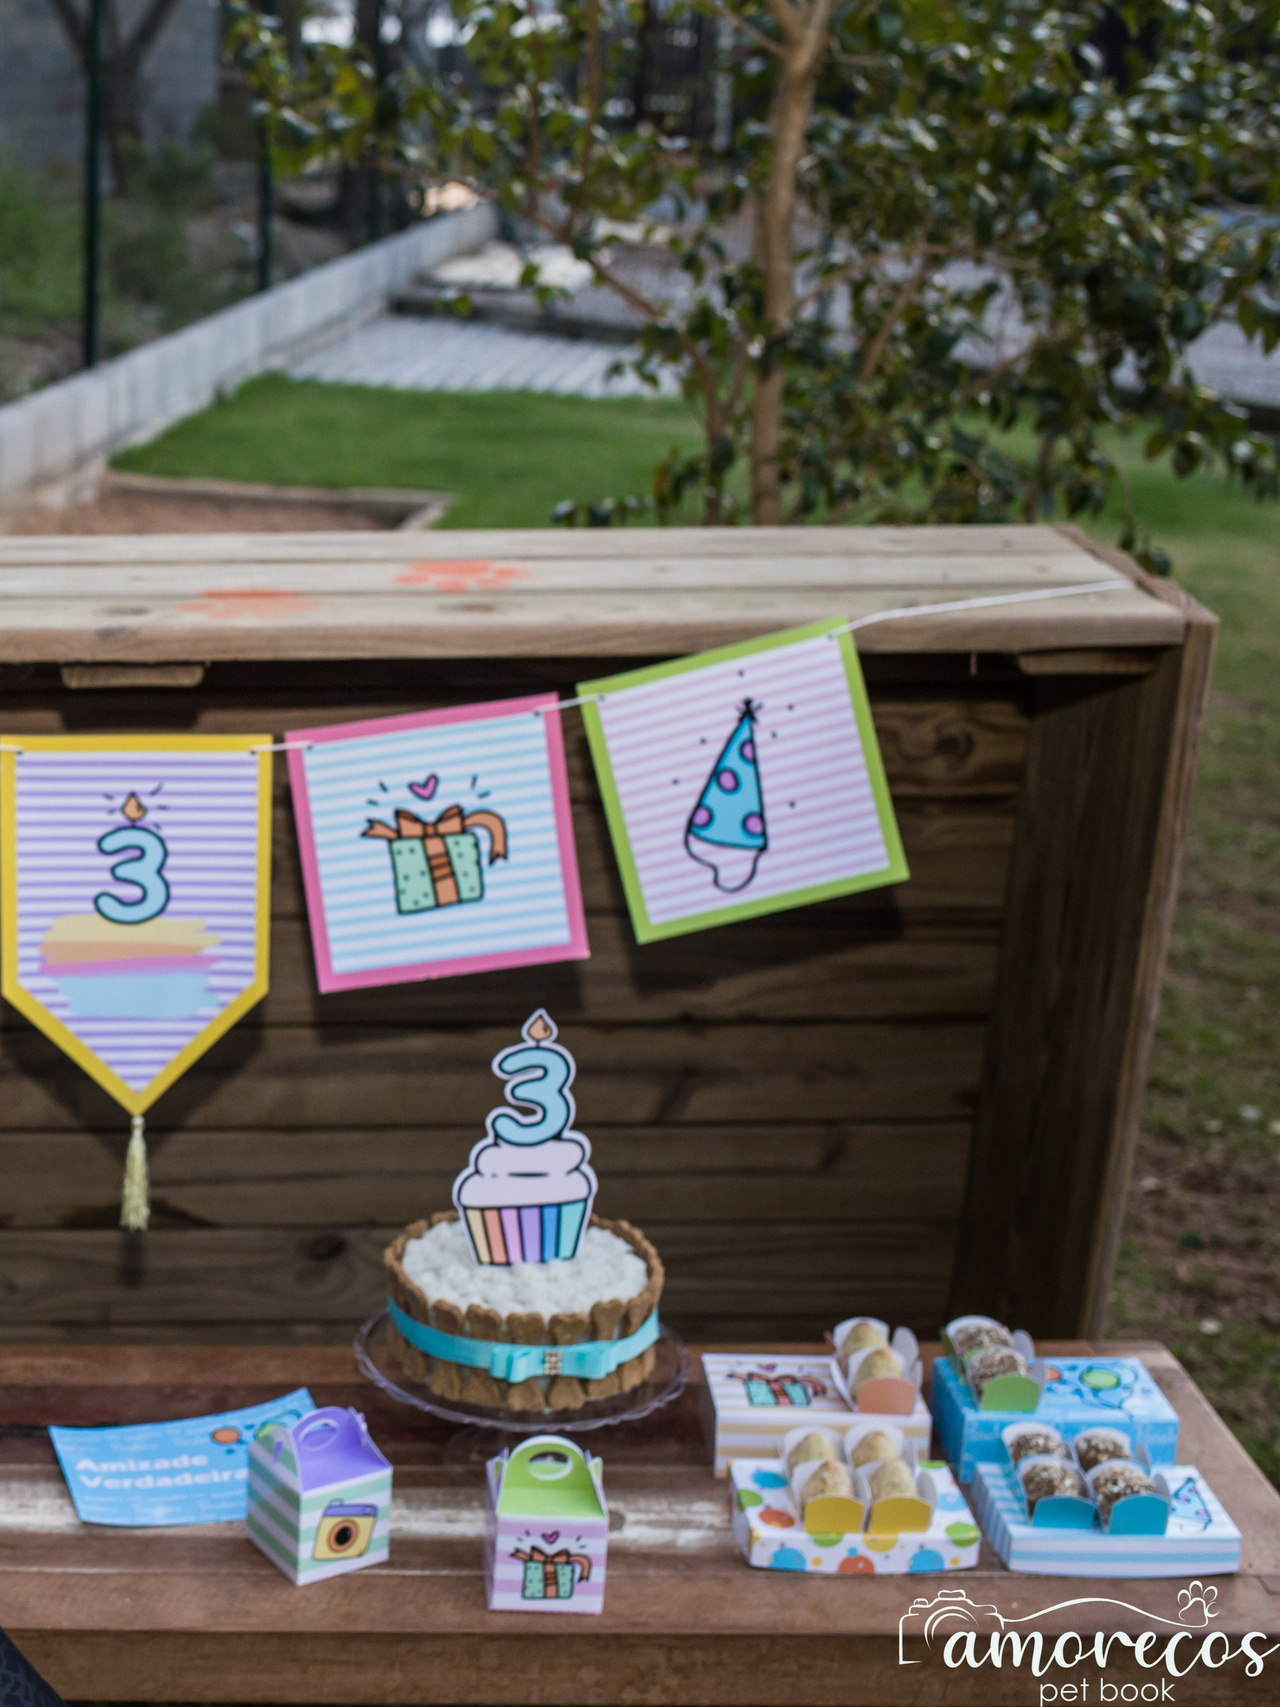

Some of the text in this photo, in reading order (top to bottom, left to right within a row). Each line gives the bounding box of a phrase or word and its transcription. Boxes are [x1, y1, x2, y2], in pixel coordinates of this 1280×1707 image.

[94, 826, 170, 925] 3
[492, 1046, 571, 1146] 3
[75, 1453, 209, 1473] Amizade
